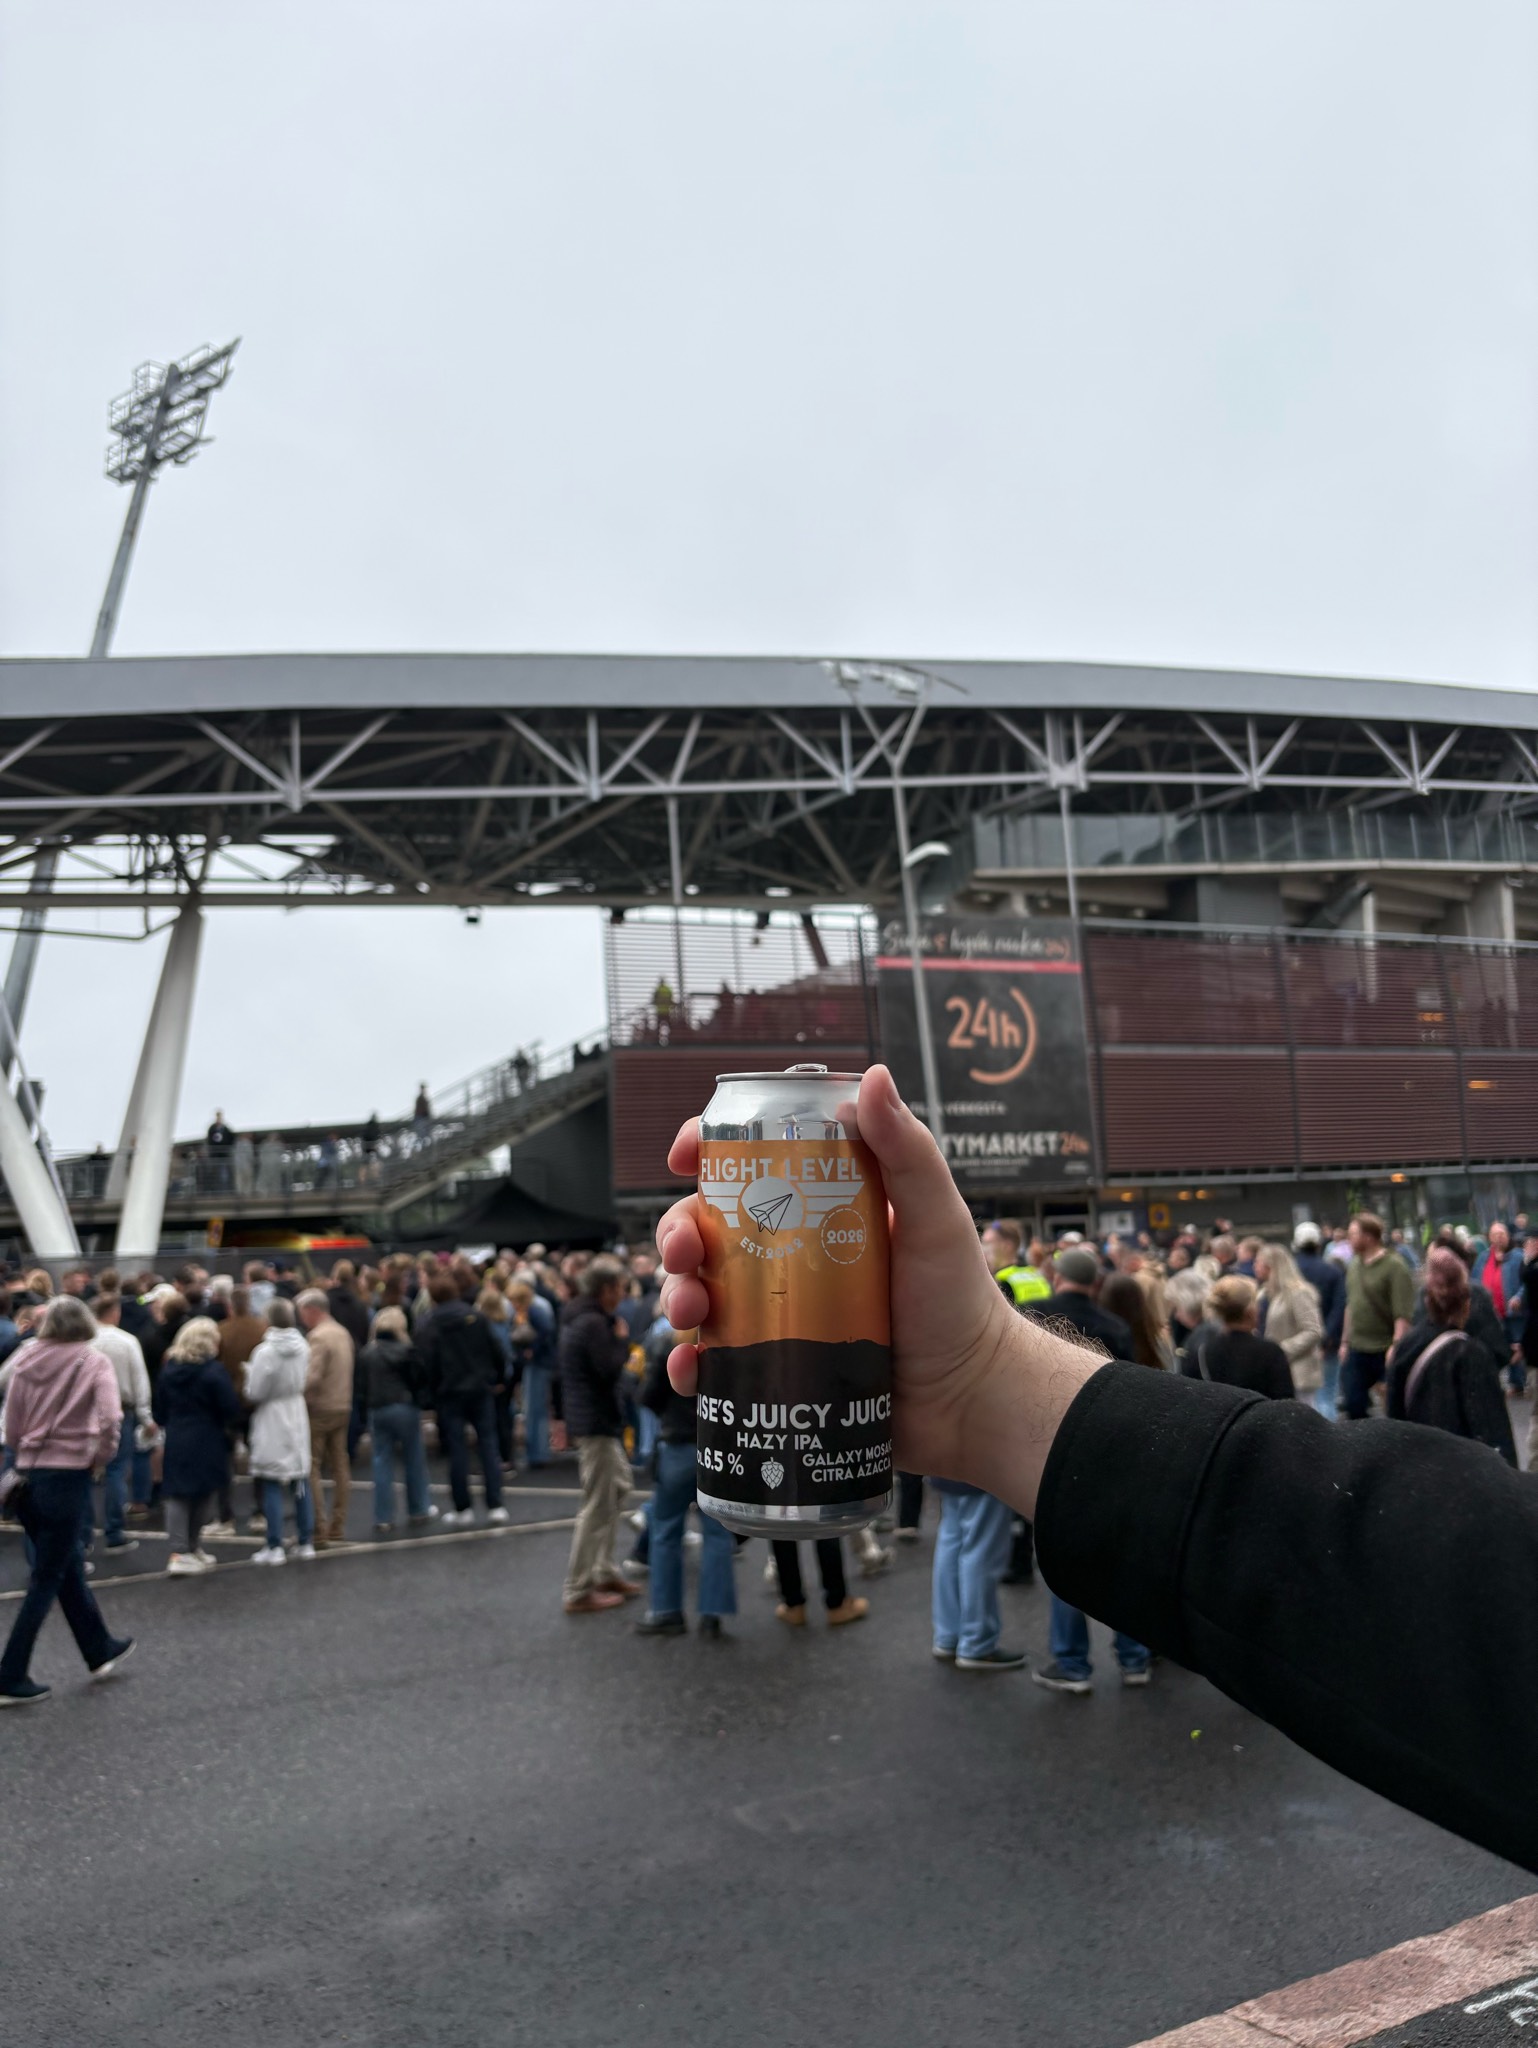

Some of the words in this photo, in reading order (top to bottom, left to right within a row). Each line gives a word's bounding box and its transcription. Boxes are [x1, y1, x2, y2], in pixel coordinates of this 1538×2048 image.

[945, 996, 1022, 1049] 24h
[941, 1131, 1058, 1156] TYMARKET
[701, 1157, 773, 1181] FLIGHT
[785, 1157, 862, 1181] LEVEL
[742, 1402, 832, 1429] JUICY
[840, 1392, 891, 1427] JUICE
[736, 1431, 788, 1450] HAZY
[794, 1433, 823, 1450] IPA
[802, 1451, 863, 1467] GALAXY
[811, 1466, 854, 1483] CITRA
